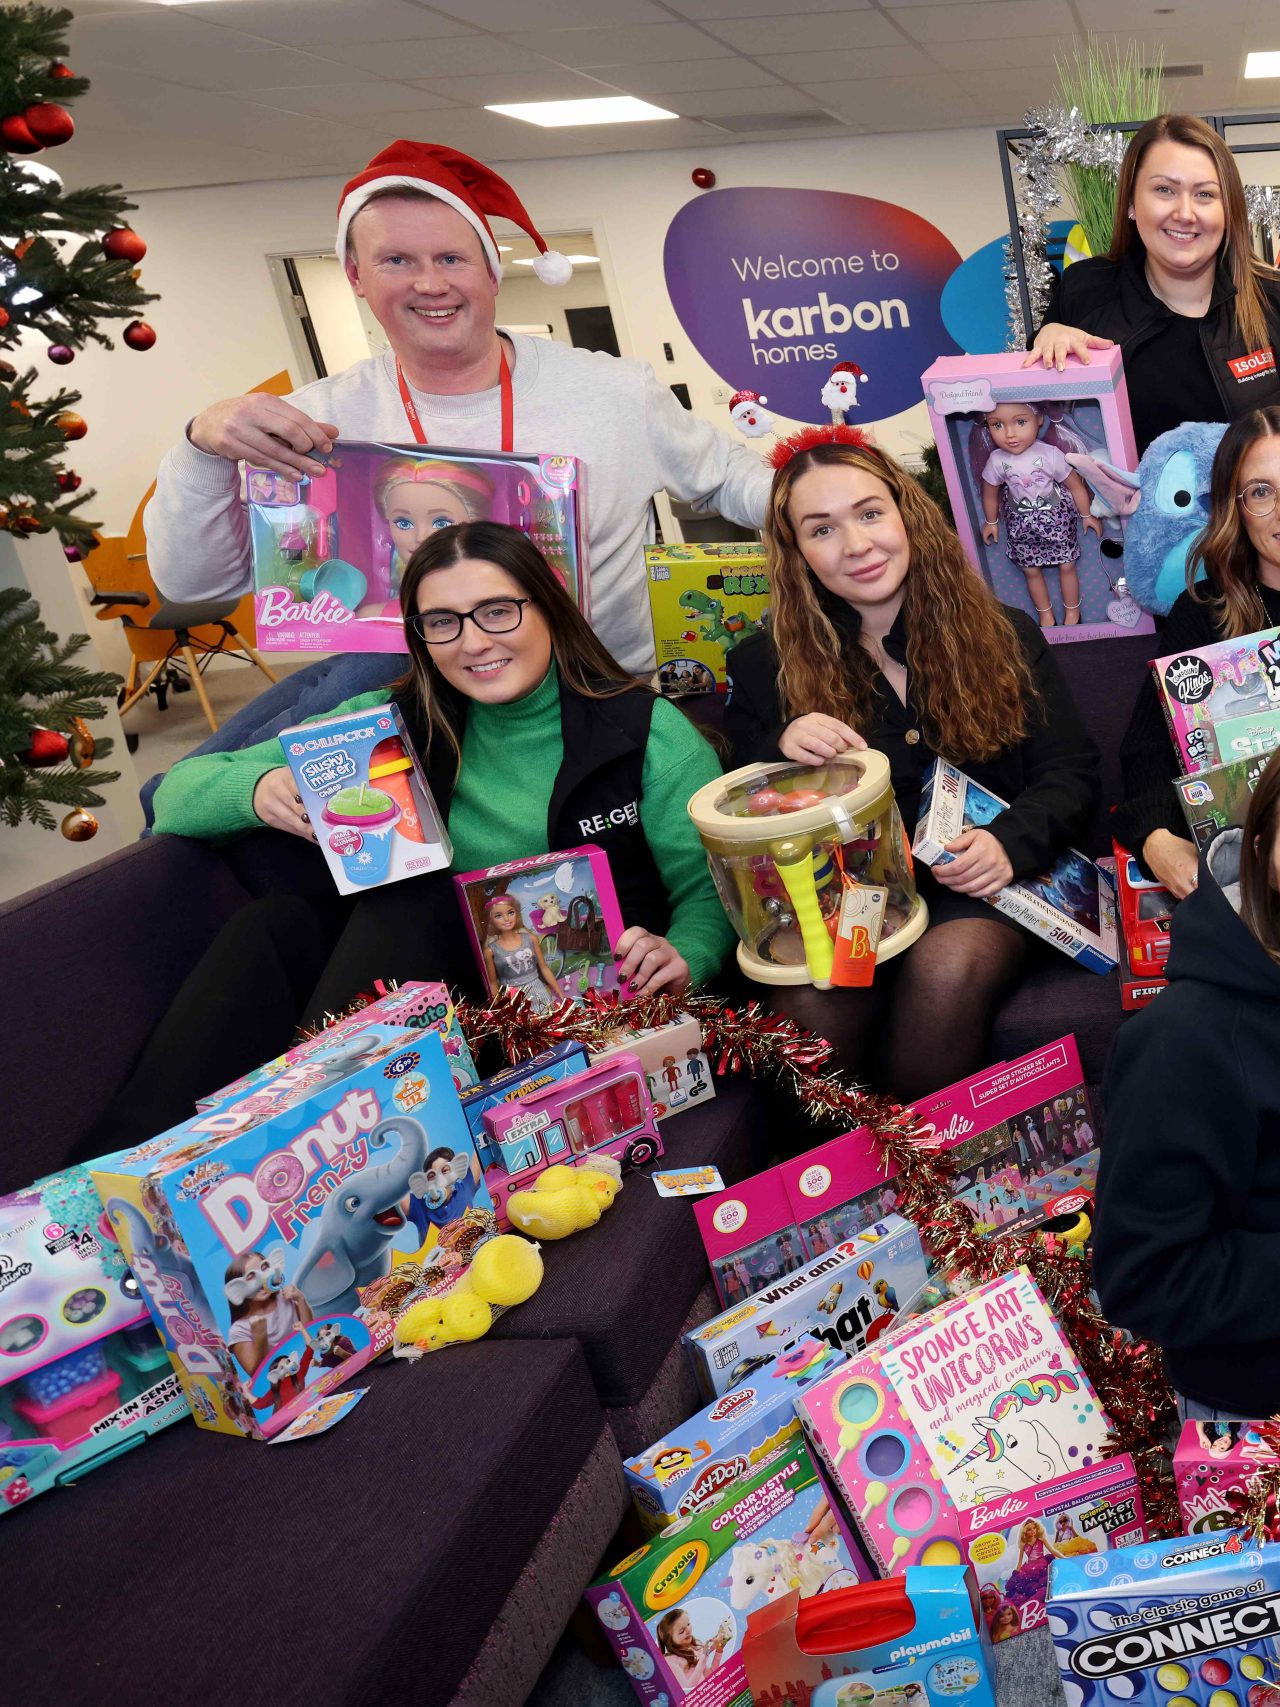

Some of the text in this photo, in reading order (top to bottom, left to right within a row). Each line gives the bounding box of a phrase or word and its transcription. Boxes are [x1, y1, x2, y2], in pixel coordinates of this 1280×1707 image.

[731, 249, 899, 282] Welcome to
[741, 292, 911, 340] karbon
[751, 342, 838, 366] homes
[259, 587, 354, 627] Barbie
[304, 726, 377, 751] CHILLFACTOR
[306, 753, 344, 777] slushy
[311, 763, 353, 787] maker
[942, 774, 959, 798] 500
[486, 851, 579, 877] Barbie
[1017, 888, 1082, 936] Ravensburger
[1049, 927, 1074, 946] 500
[1085, 946, 1115, 966] Ravensburger
[404, 1002, 448, 1029] Cute
[978, 1057, 1062, 1100] SUPER SET D'AUTOCOLLANTS
[991, 1057, 1046, 1087] SUPER STICKER SET
[189, 1060, 326, 1132] Donut
[402, 1086, 420, 1098] GAMES
[406, 1092, 425, 1108] £12
[504, 1075, 556, 1103] SPIDER-MAN
[689, 1079, 708, 1098] GS
[509, 1117, 545, 1139] EXTRA
[203, 1087, 382, 1257] Donut
[807, 1175, 824, 1188] 500
[271, 1135, 369, 1243] Frenzy
[44, 1222, 64, 1240] 6
[721, 1210, 739, 1223] 500
[78, 1241, 98, 1256] DECO
[758, 1258, 835, 1305] What am
[131, 1254, 223, 1374] Donut
[374, 1323, 393, 1340] the
[899, 1286, 1025, 1381] SPONGE ART
[723, 1349, 740, 1366] HUB
[910, 1314, 1044, 1413] UNICORNS
[711, 1389, 753, 1418] Play-Doh
[929, 1349, 1054, 1431] and magical creatures
[93, 1401, 138, 1436] MIX'IN
[682, 1458, 745, 1512] Play-Doh
[1038, 1485, 1062, 1498] CRYSTAL
[1046, 1481, 1126, 1515] CRYSTAL BALLGOWN SCIENCE
[736, 1484, 786, 1526] UNICORN
[740, 1495, 795, 1540] STYLE-MICH EINHORN
[744, 1510, 767, 1529] LICORNE
[820, 1447, 891, 1577] SPONGE ART UNICORNS
[970, 1498, 1029, 1531] Barbie
[1079, 1502, 1110, 1521] Science
[1084, 1499, 1135, 1531] Maker
[1104, 1511, 1134, 1531] Kitz
[976, 1547, 1001, 1557] CRYSTAL
[1161, 1542, 1227, 1568] CONNECT
[1225, 1534, 1243, 1554] 4
[652, 1548, 698, 1598] Crayola
[1112, 1580, 1264, 1629] The classic game of
[890, 1627, 973, 1662] playmobil
